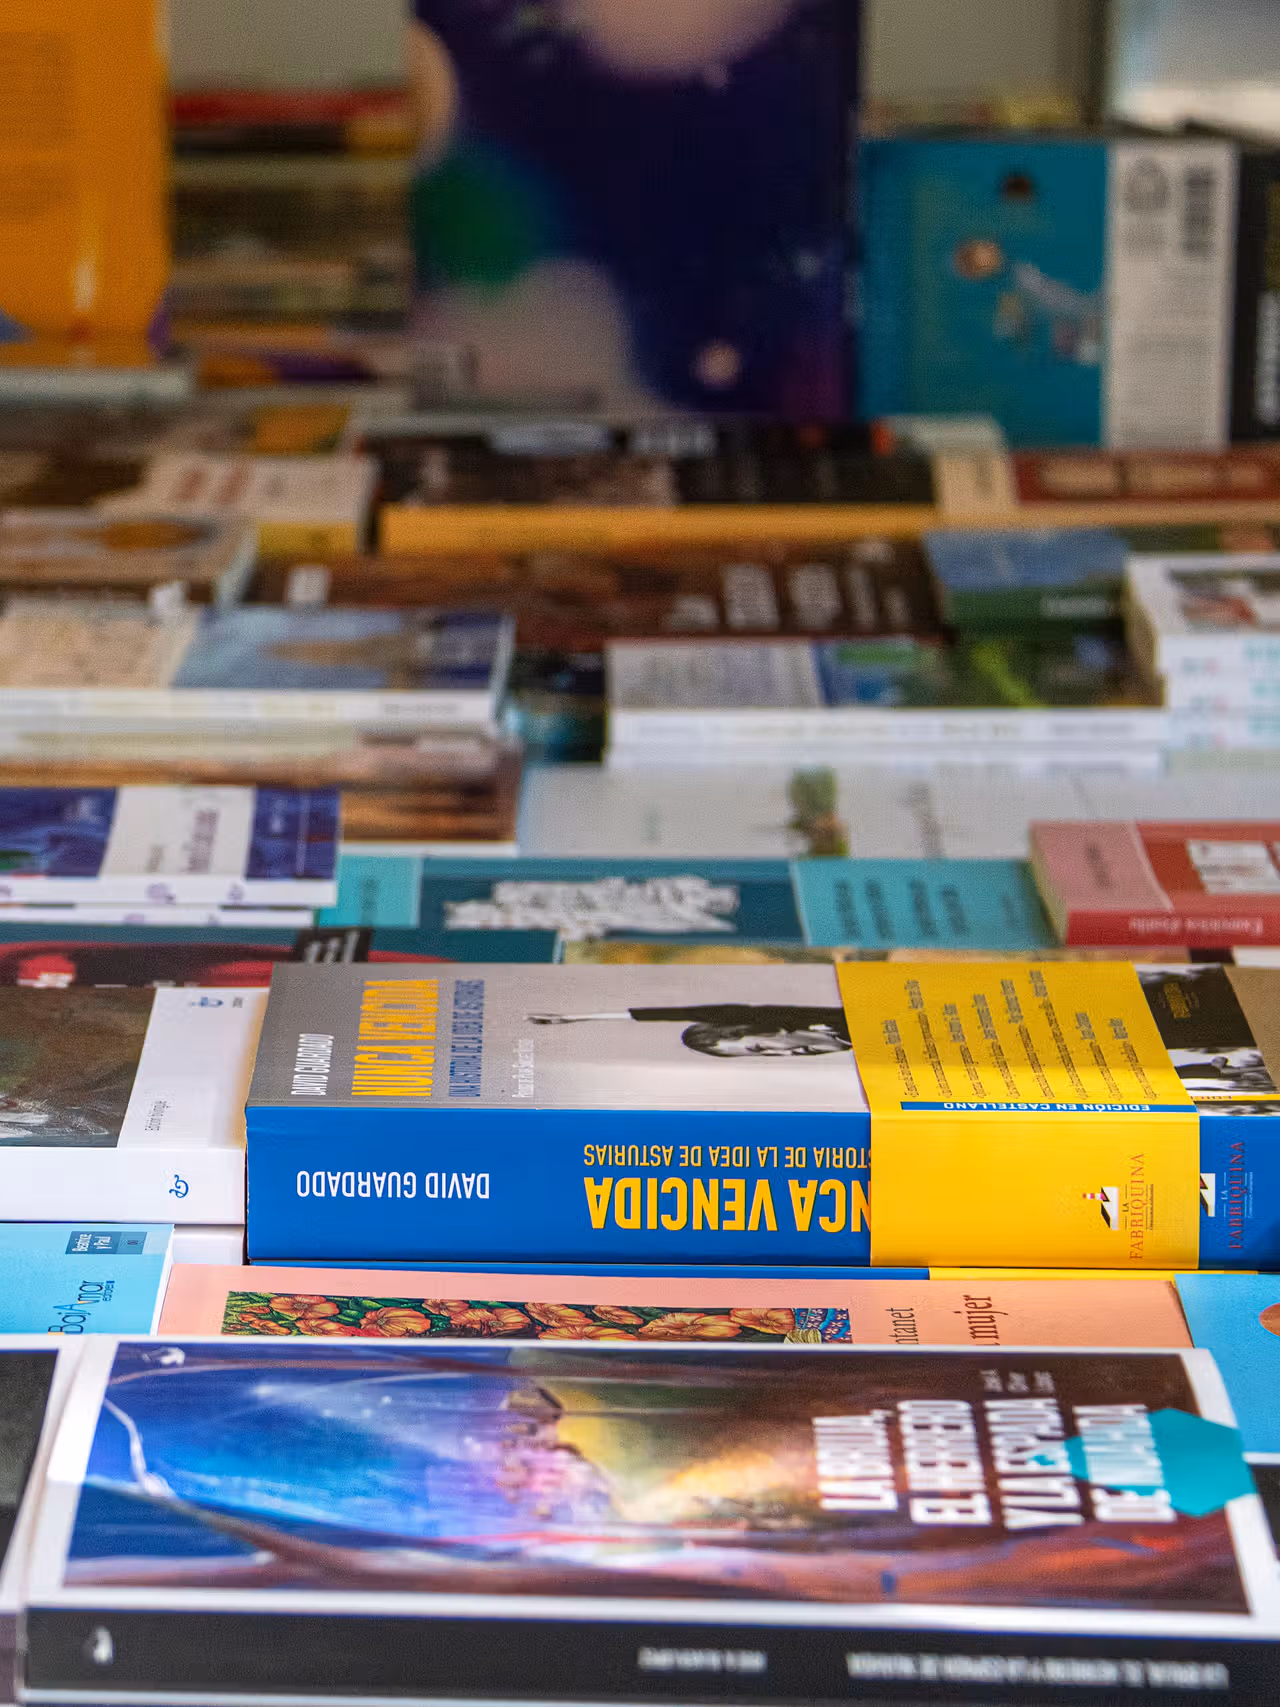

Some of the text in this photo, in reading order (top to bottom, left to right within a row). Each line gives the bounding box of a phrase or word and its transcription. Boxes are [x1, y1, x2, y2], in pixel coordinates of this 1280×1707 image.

[351, 979, 439, 1097] NUNCA VENCIDA
[290, 1033, 335, 1096] DAVID GUARDADO
[943, 1102, 1150, 1112] EDICIÓN EN CASTELLANO
[583, 1144, 677, 1167] ASTURIAS
[680, 1145, 701, 1167] DE
[708, 1146, 751, 1168] IDEA
[757, 1146, 779, 1168] LA
[783, 1147, 807, 1168] DE
[296, 1171, 490, 1199] DAVID GUARDADO
[1228, 1141, 1247, 1250] FABRIQUINA
[583, 1177, 777, 1234] VENCIDA
[1129, 1152, 1147, 1260] FABRIQUINA
[952, 1293, 1009, 1341] mujer
[983, 1397, 1072, 1473] ESPADA
[819, 1478, 899, 1512] LA
[999, 1476, 1082, 1508] LA
[1089, 1488, 1177, 1524] DE
[909, 1493, 993, 1526] EL
